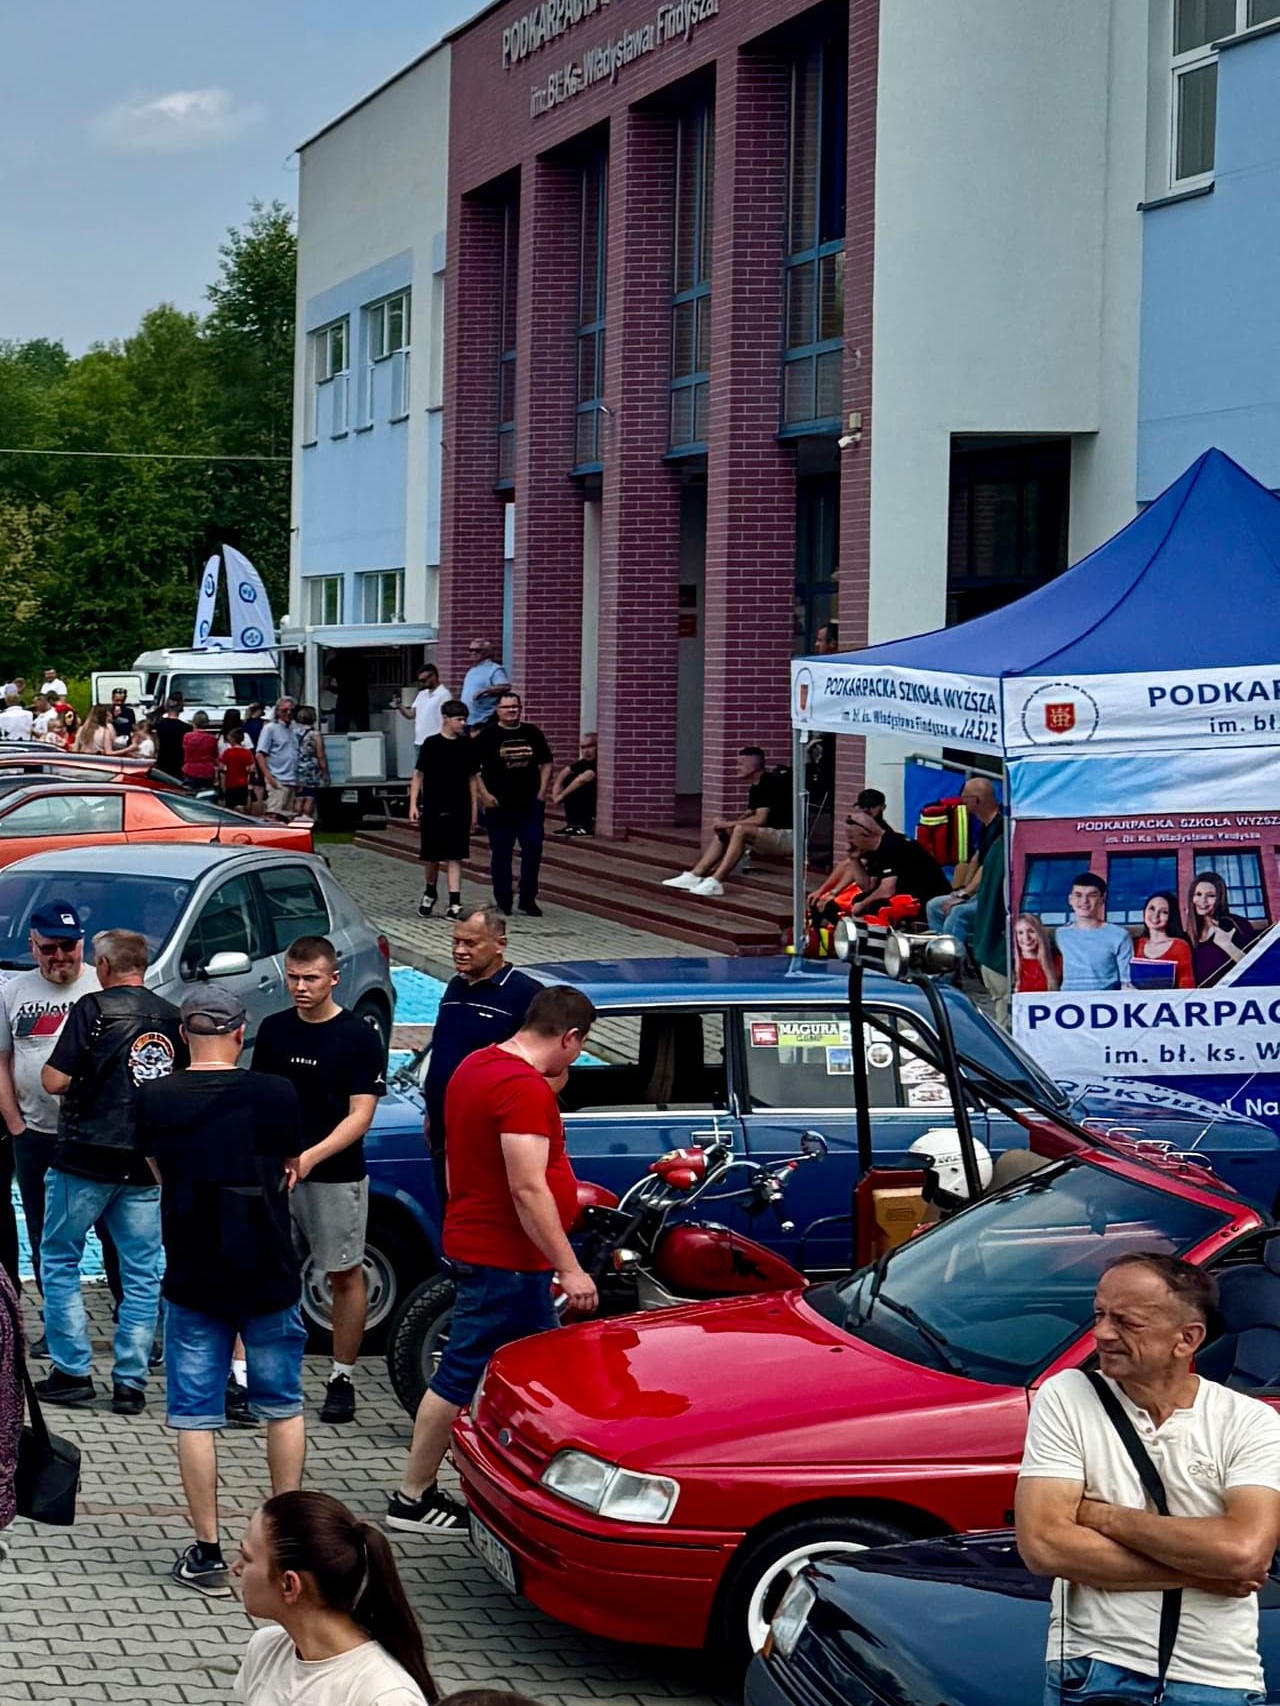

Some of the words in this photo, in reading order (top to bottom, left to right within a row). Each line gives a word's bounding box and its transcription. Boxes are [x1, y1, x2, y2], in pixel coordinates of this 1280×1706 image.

[583, 24, 656, 85] Władysława
[824, 677, 897, 698] PODKARPACKA
[899, 682, 942, 706] SZKOŁA
[943, 686, 997, 714] WYŻSZA
[1210, 717, 1245, 733] im.
[1077, 819, 1175, 832] PODKARPACKA
[779, 1023, 838, 1035] MAGURA
[1105, 1046, 1149, 1064] im.
[1160, 1044, 1195, 1062] bł.
[1207, 1043, 1245, 1061] ks.
